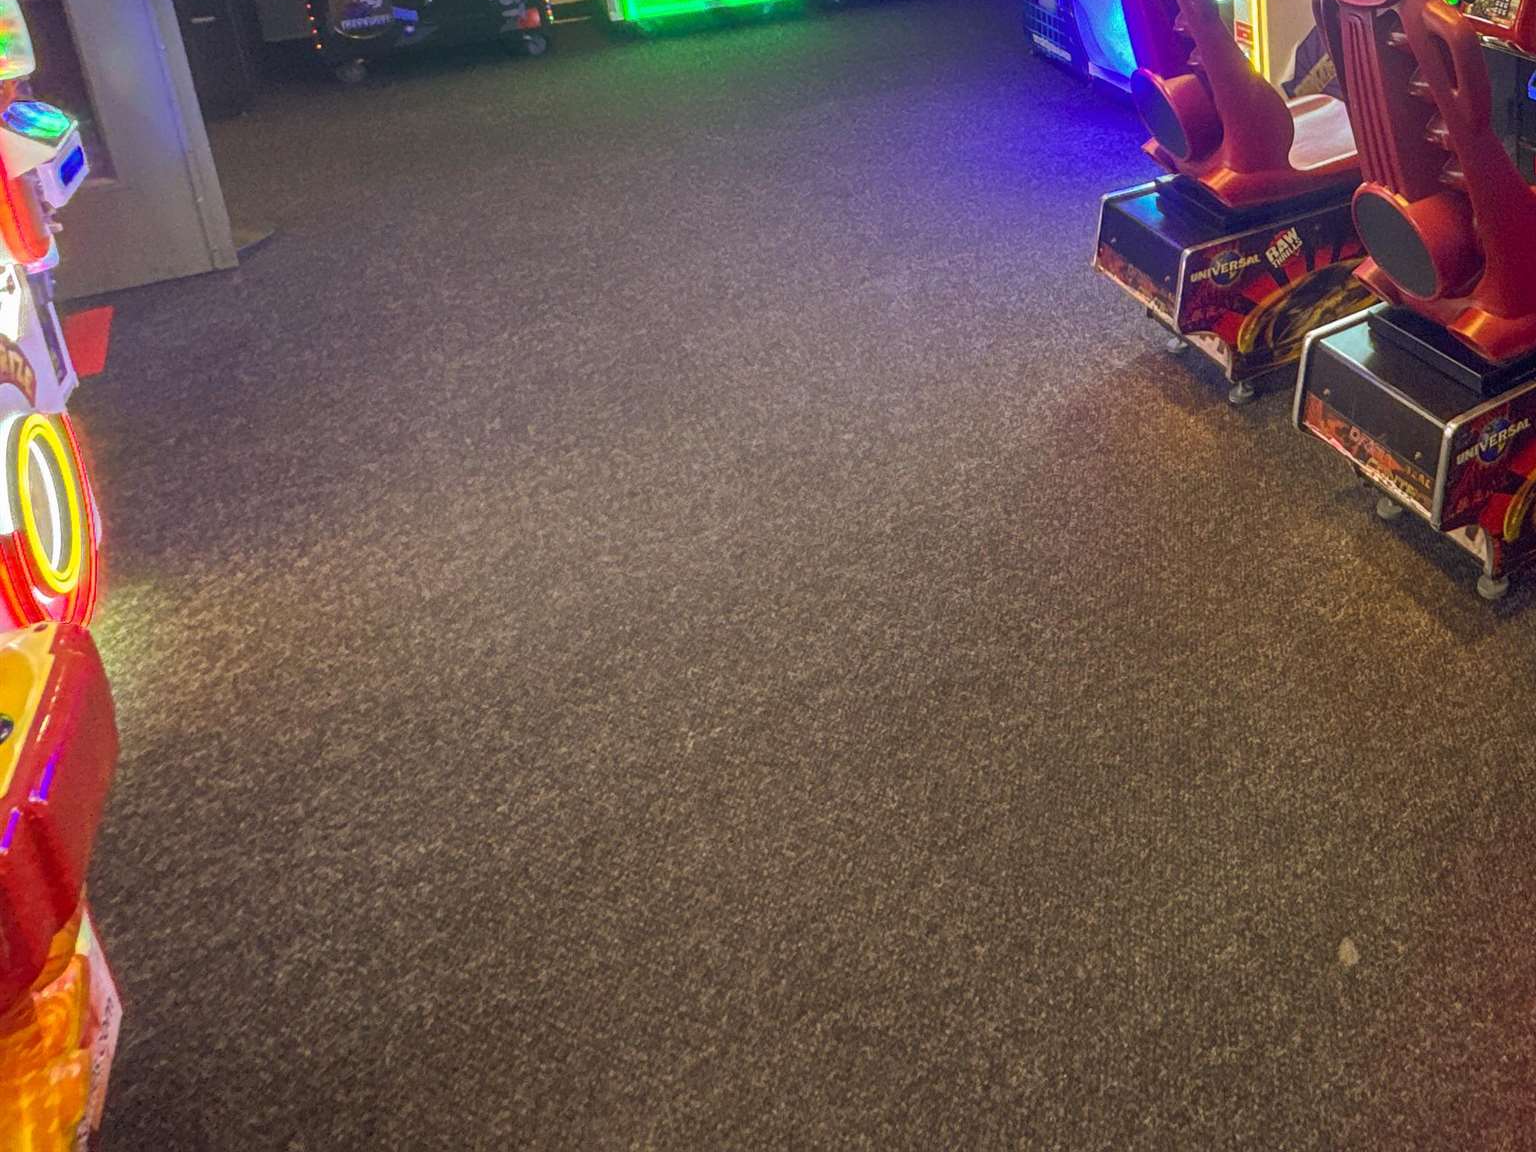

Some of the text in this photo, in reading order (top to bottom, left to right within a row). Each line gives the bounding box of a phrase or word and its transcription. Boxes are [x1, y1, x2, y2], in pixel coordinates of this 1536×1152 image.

[1189, 226, 1300, 284] UNIVERSAL RAW
[1455, 416, 1533, 466] UNIVERSAL
